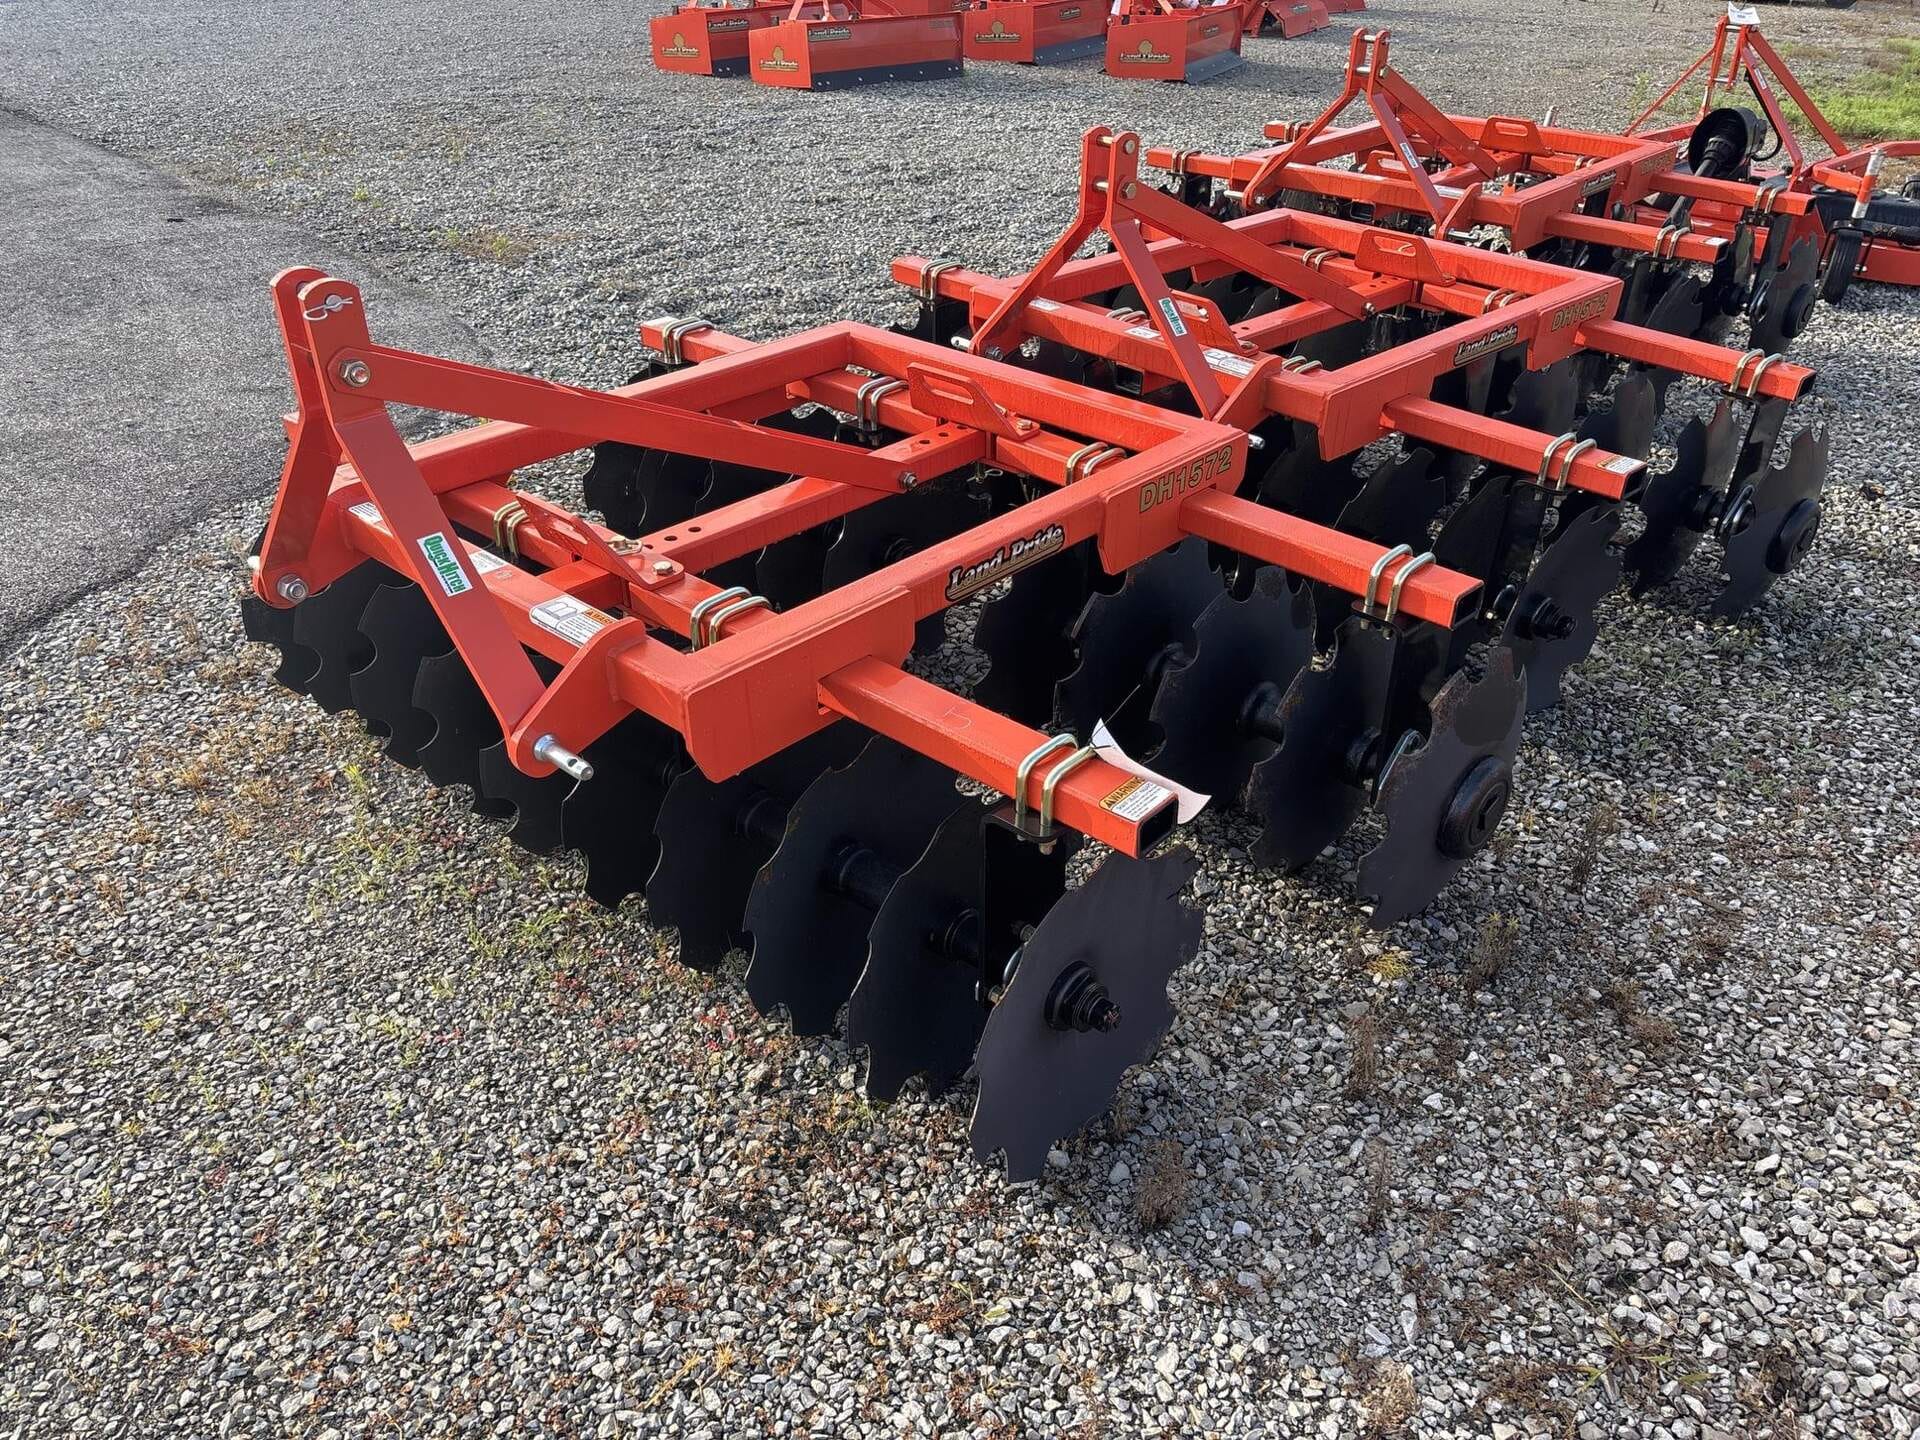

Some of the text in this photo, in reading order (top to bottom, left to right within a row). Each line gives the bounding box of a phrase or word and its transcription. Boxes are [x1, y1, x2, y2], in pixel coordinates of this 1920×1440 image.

[1457, 336, 1487, 357] Land
[1139, 445, 1232, 513] DH1572
[949, 523, 1063, 592] Land Pride
